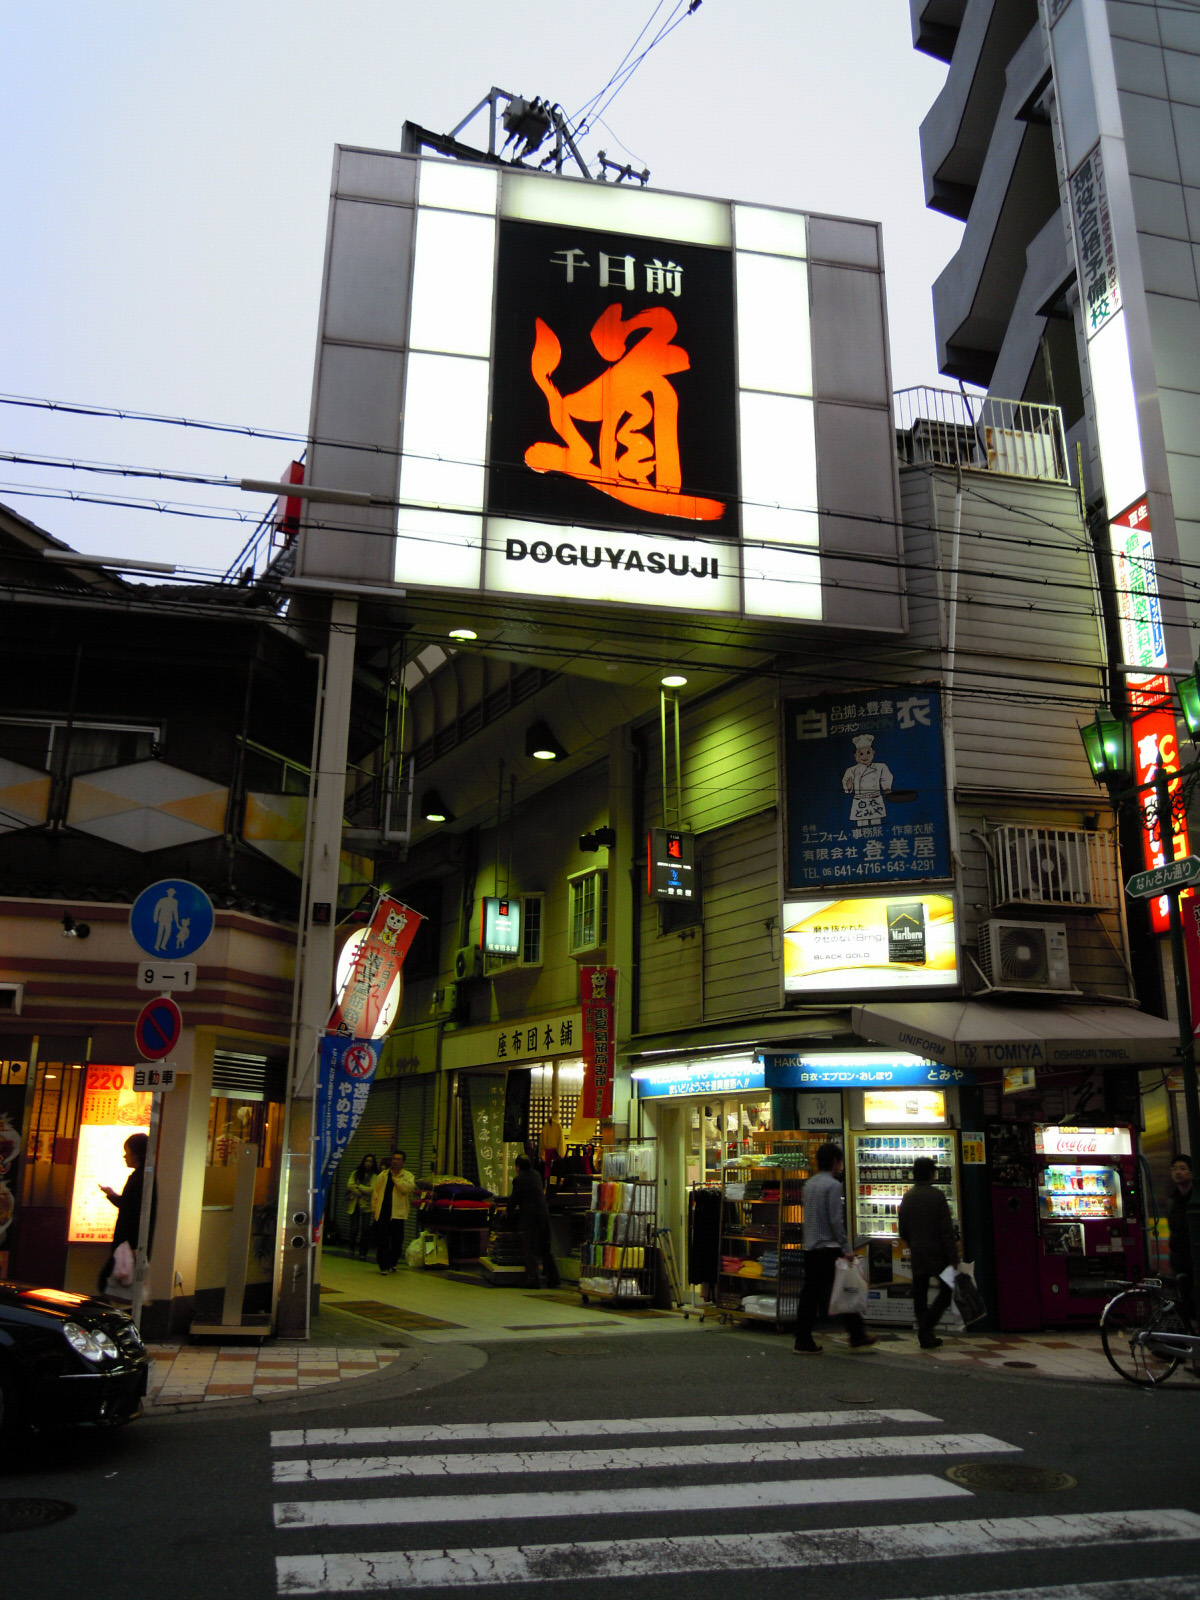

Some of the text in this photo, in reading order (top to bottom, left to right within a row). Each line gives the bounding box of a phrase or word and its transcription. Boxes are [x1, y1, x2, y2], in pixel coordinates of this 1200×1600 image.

[1072, 159, 1112, 329] 現役合格予備校
[549, 248, 686, 297] 千日前
[523, 302, 727, 522] 道
[506, 538, 719, 580] DOGUYASUJI
[830, 700, 894, 721] 品揃え豊富
[896, 696, 931, 730] 衣
[796, 709, 828, 740] 白
[855, 807, 884, 817] とみや
[858, 800, 880, 808] 白衣
[803, 836, 937, 862] 有限会社 登美屋
[803, 868, 820, 879] TEL
[1135, 862, 1192, 891] なんさん通り
[892, 926, 922, 941] Marlboro
[845, 952, 870, 960] GOLD
[497, 1020, 573, 1058] 座布団本舗
[898, 1031, 946, 1056] UNIFORM
[983, 1043, 1043, 1061] TOMIYA
[1054, 1049, 1129, 1060] OSHIBORI TOWEL
[87, 1072, 124, 1090] 220
[134, 1070, 174, 1086] 自動車
[927, 1069, 964, 1081] とみや
[807, 1117, 834, 1125] TOMIYA
